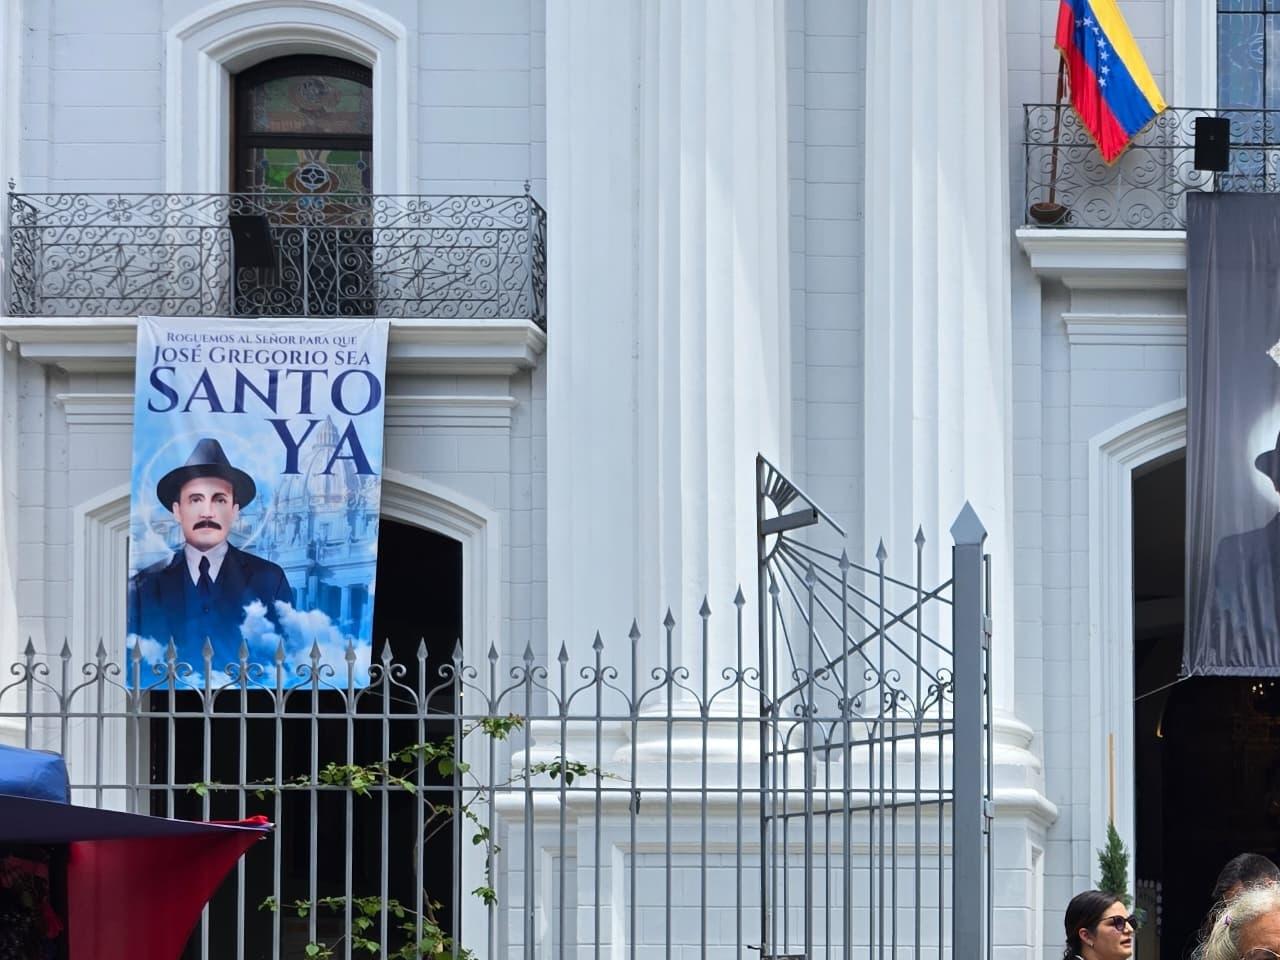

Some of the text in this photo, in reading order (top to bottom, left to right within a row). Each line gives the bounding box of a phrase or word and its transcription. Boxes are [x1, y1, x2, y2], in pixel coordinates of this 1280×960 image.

[153, 343, 371, 366] JOSÉ GREGORIO SEA
[166, 332, 358, 347] ROGUEMOS AL SEÑOR PARA QUE
[147, 365, 382, 416] SANTO
[264, 418, 380, 476] YA
